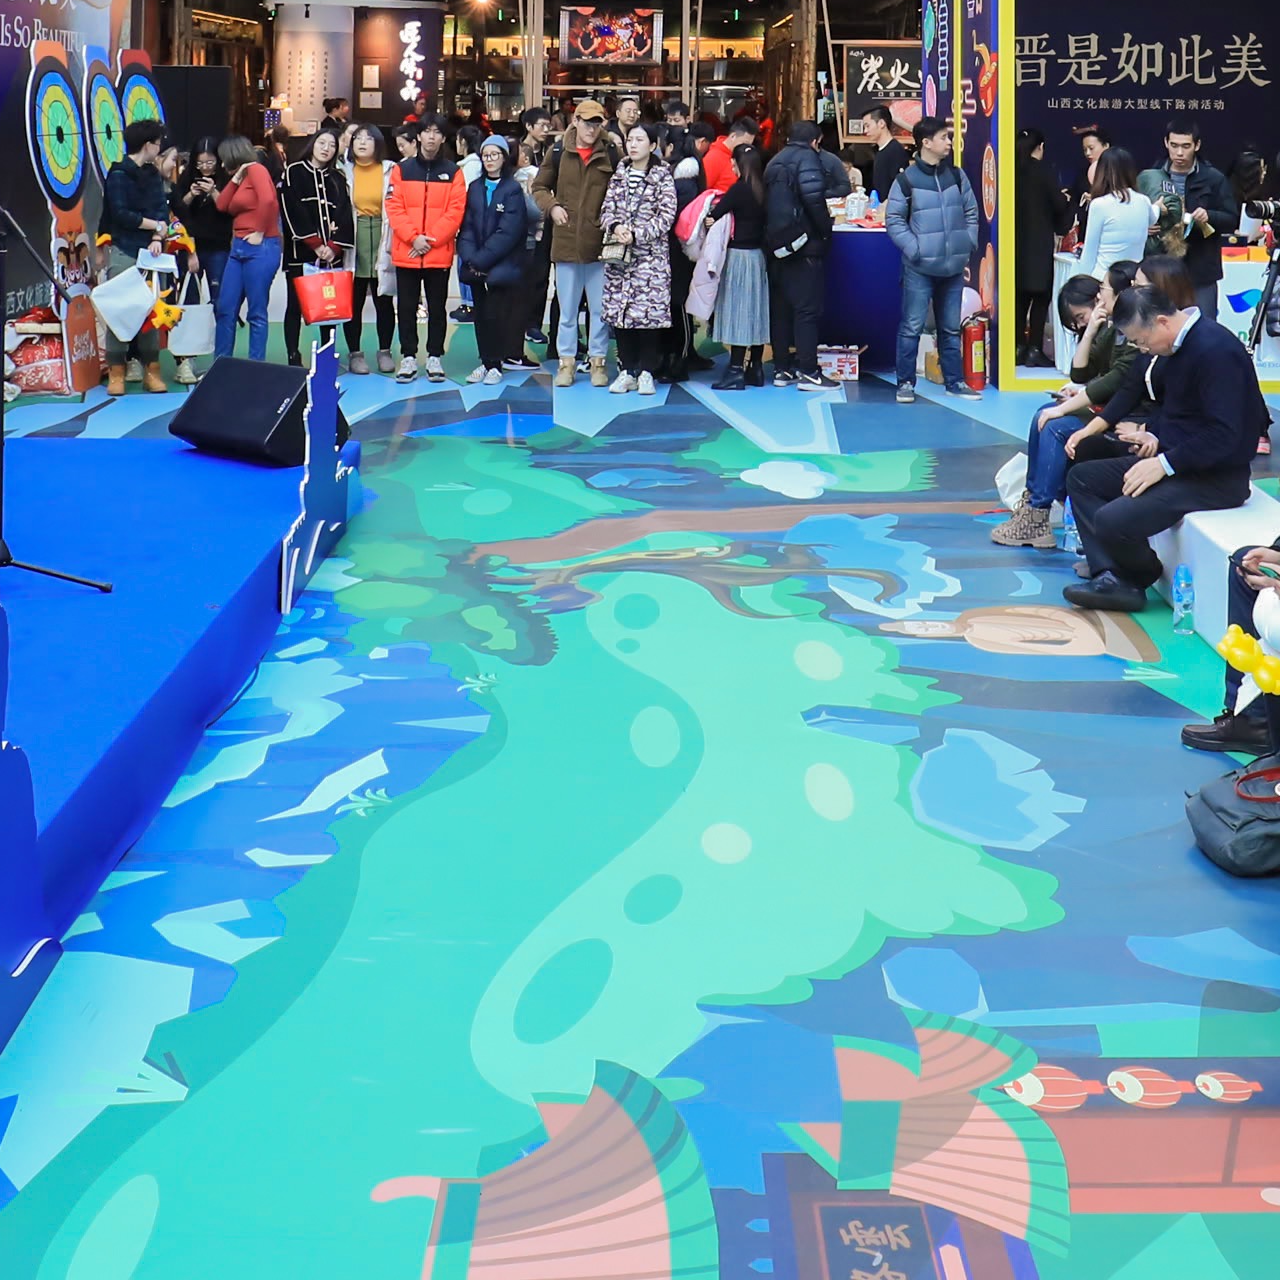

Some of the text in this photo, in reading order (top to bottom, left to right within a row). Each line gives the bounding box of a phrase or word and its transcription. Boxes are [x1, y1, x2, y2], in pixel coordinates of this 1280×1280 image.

[857, 53, 923, 94] 炭火
[1015, 31, 1272, 90] 晋是如此美
[1047, 97, 1225, 110] 山西文化旅游大型线下路演活动
